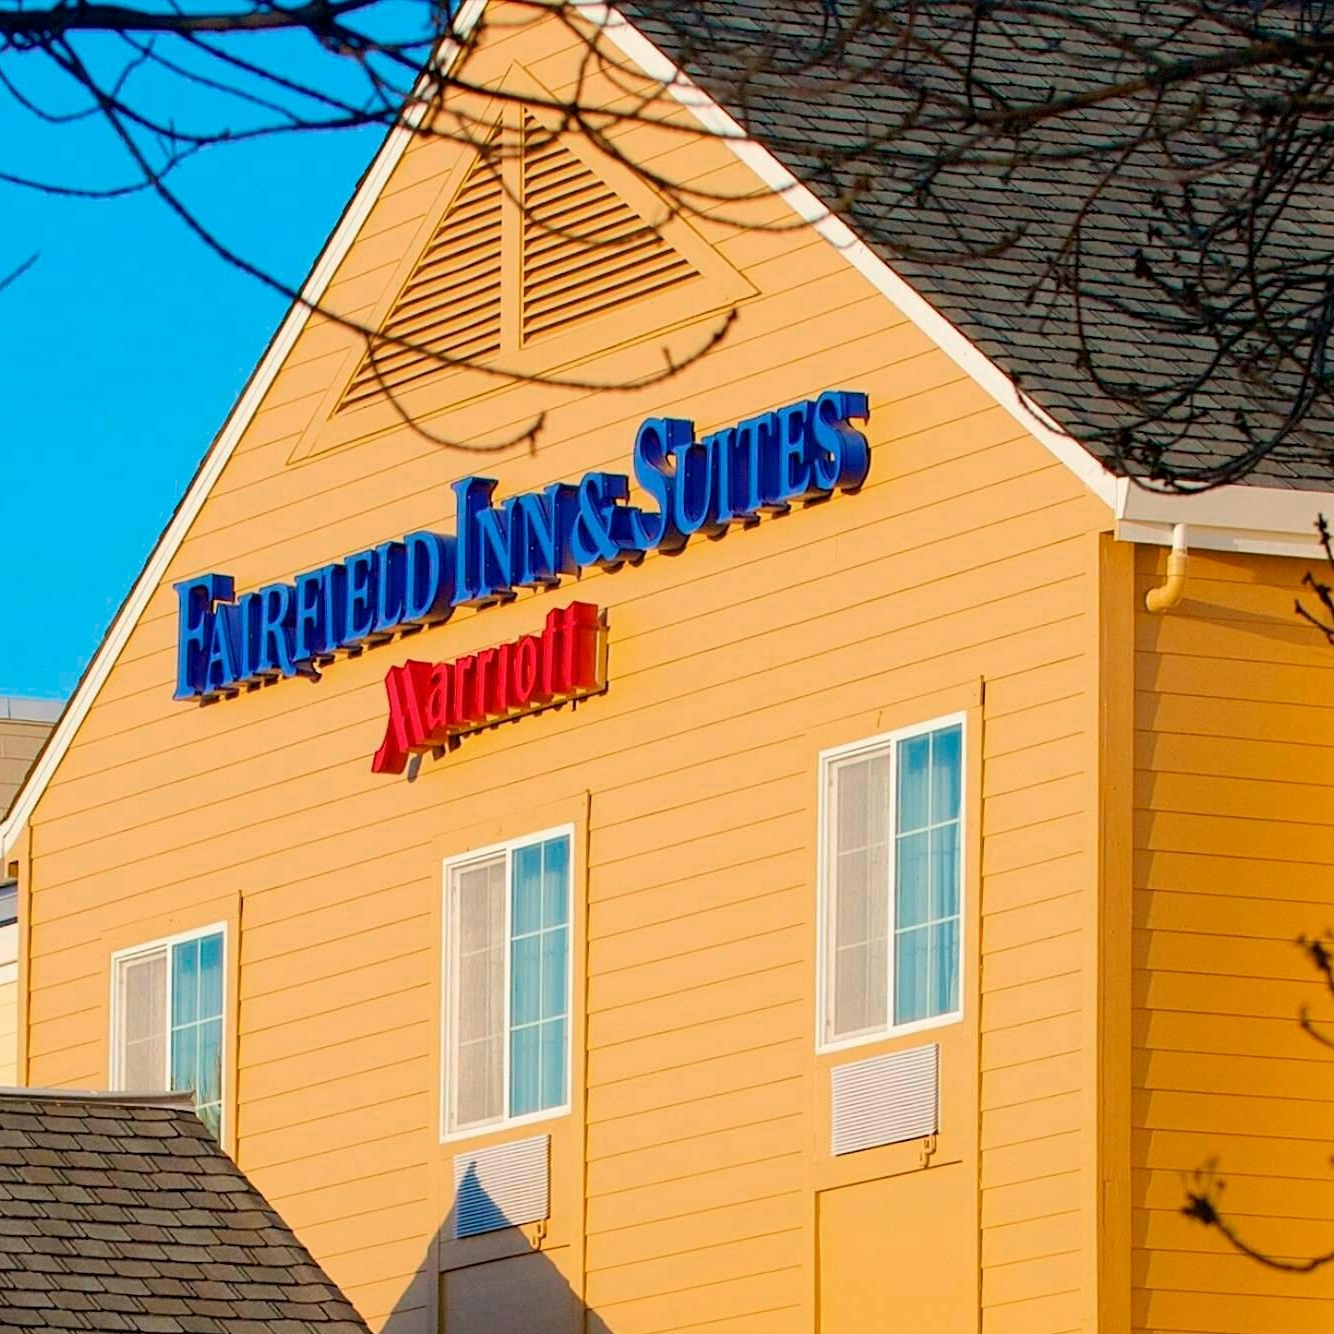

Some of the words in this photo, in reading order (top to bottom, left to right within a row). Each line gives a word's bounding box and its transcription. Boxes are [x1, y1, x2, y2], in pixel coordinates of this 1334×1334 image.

[173, 530, 455, 702] FAIRFIELD
[450, 475, 581, 608] INN
[633, 390, 871, 552] SUITES
[371, 601, 607, 775] Marriott
